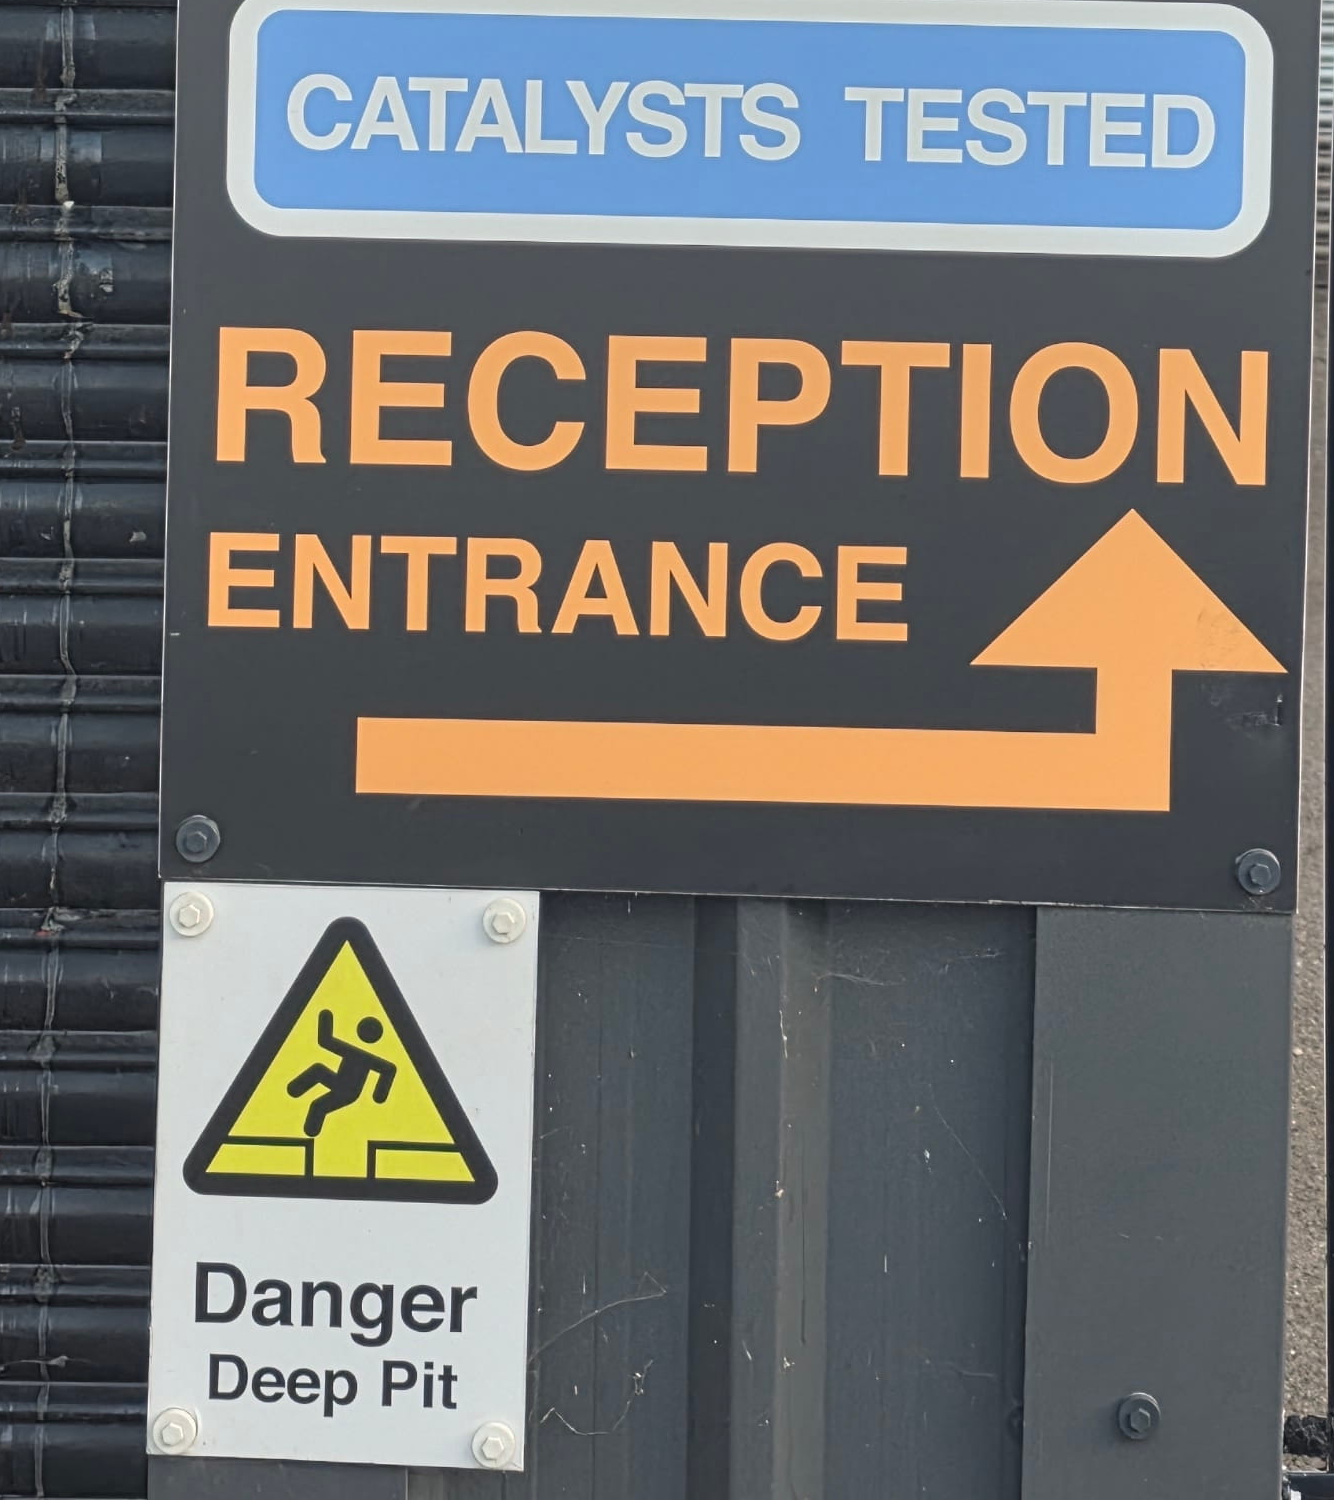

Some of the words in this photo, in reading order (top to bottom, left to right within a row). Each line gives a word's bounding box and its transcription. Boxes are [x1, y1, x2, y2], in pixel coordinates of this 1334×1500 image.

[285, 73, 802, 162] CATALYSTS
[844, 86, 1218, 172] TESTED
[214, 325, 1270, 488] RECEPTION
[206, 531, 909, 643] ENTRANCE
[193, 1260, 478, 1348] Danger
[207, 1352, 359, 1418] Deep
[380, 1359, 458, 1411] Pit
